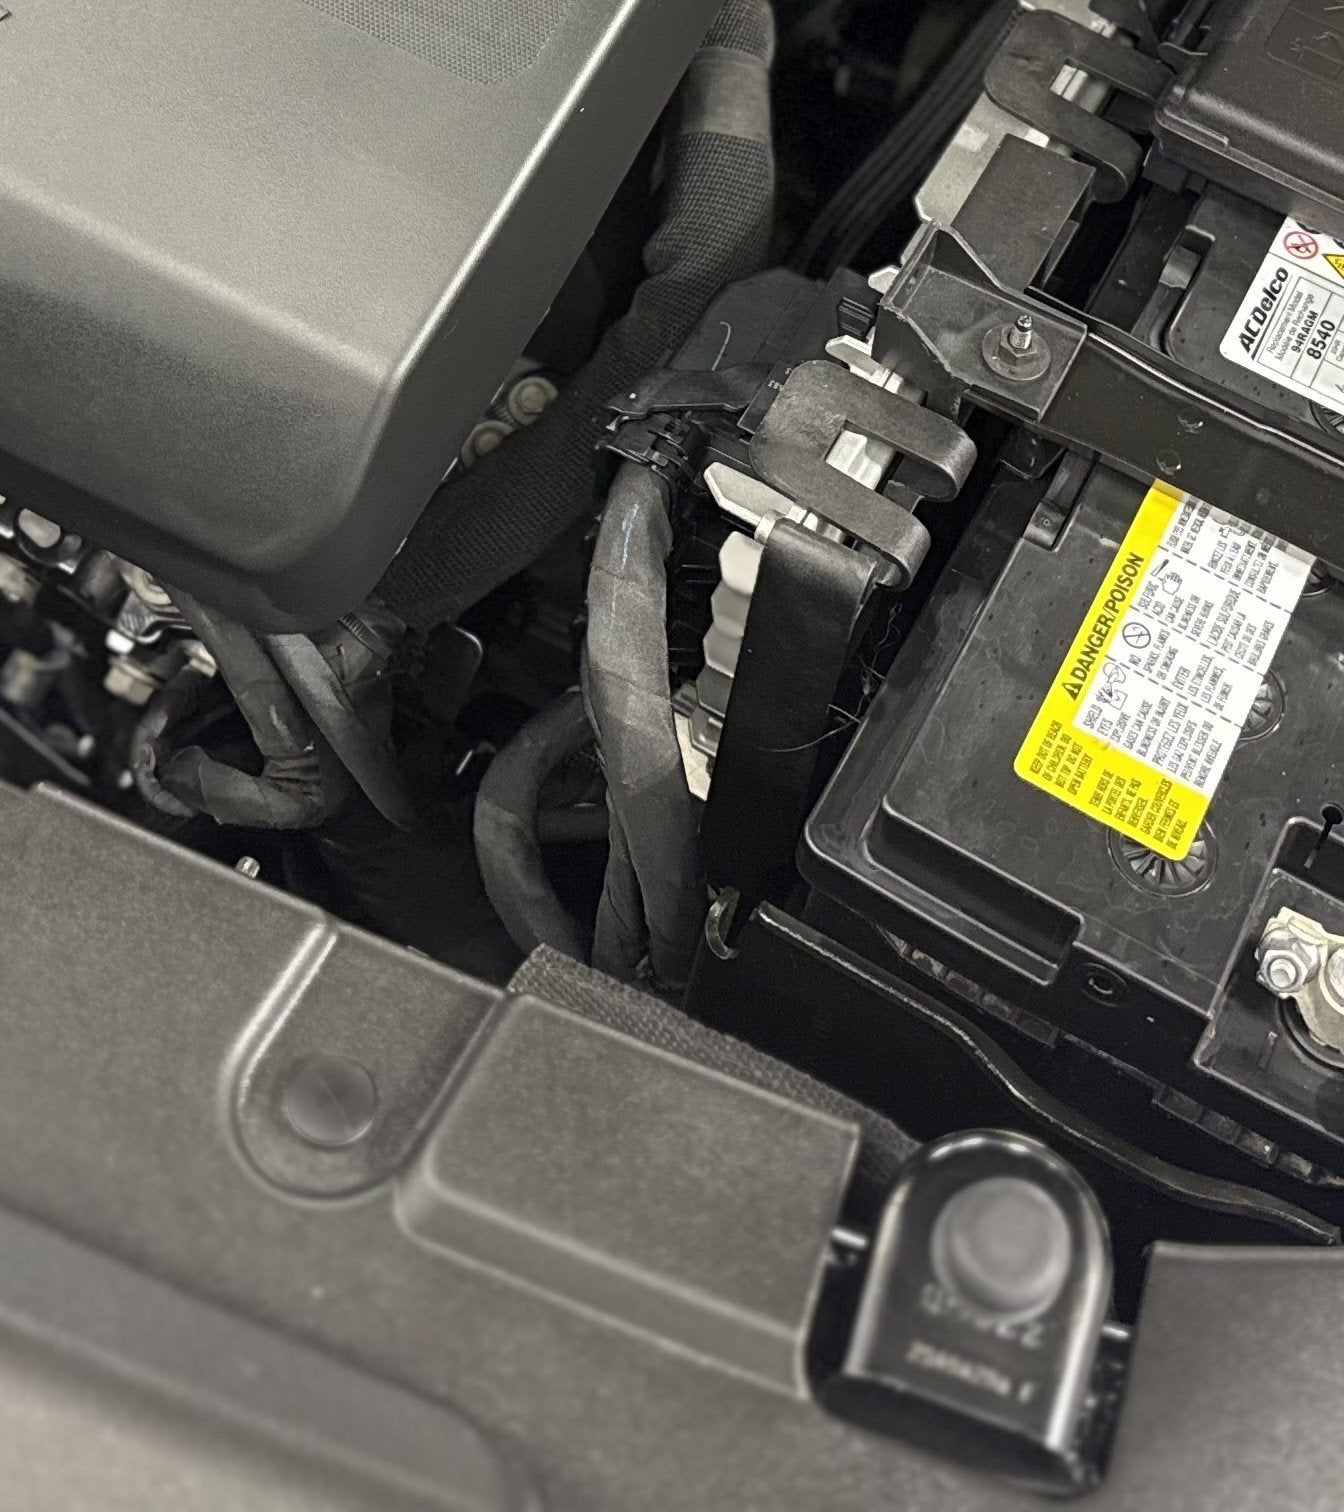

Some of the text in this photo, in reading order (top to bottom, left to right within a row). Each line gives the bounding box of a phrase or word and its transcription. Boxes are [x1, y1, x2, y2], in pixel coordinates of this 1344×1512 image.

[1239, 267, 1288, 352] ACDelco
[1290, 309, 1318, 353] 94RAGM
[1306, 319, 1335, 359] 8540
[1070, 552, 1143, 681] DANGER/POISON
